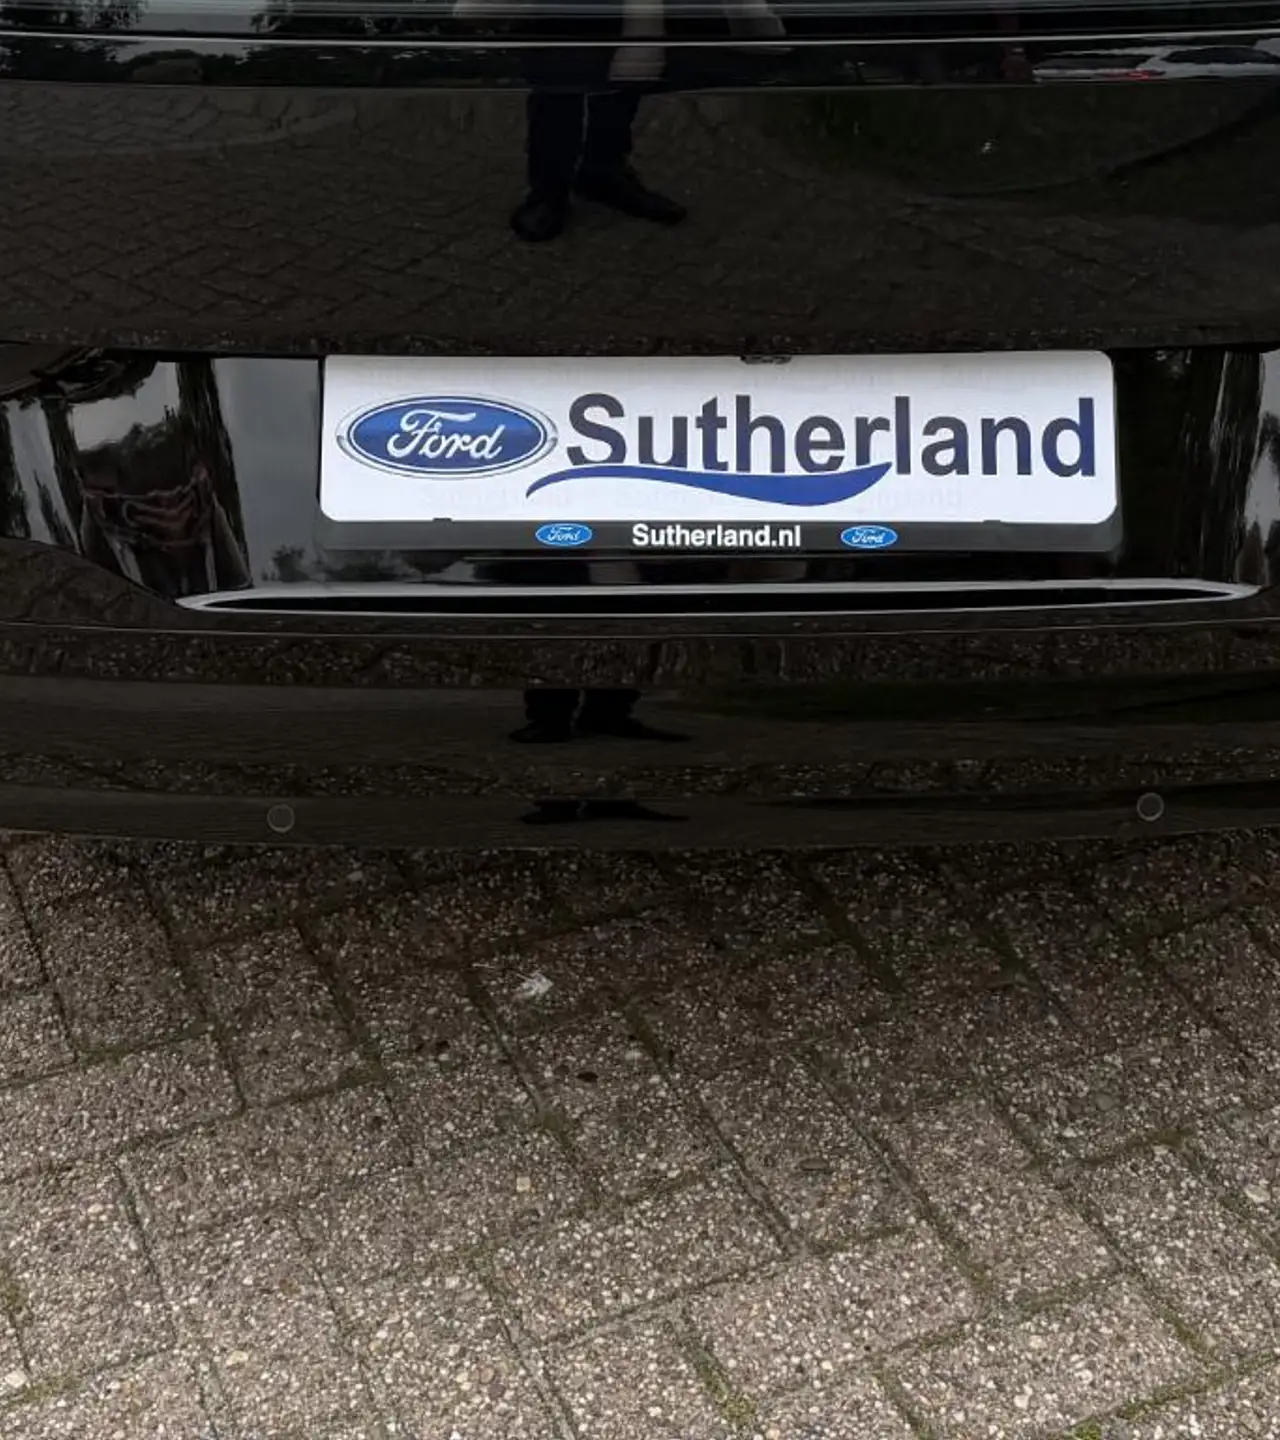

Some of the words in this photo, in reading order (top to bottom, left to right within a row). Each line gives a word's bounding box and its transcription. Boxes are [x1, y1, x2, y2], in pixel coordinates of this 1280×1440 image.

[385, 407, 503, 462] Ford
[564, 393, 1096, 478] Sutherland
[631, 523, 802, 548] Sutherland.nl
